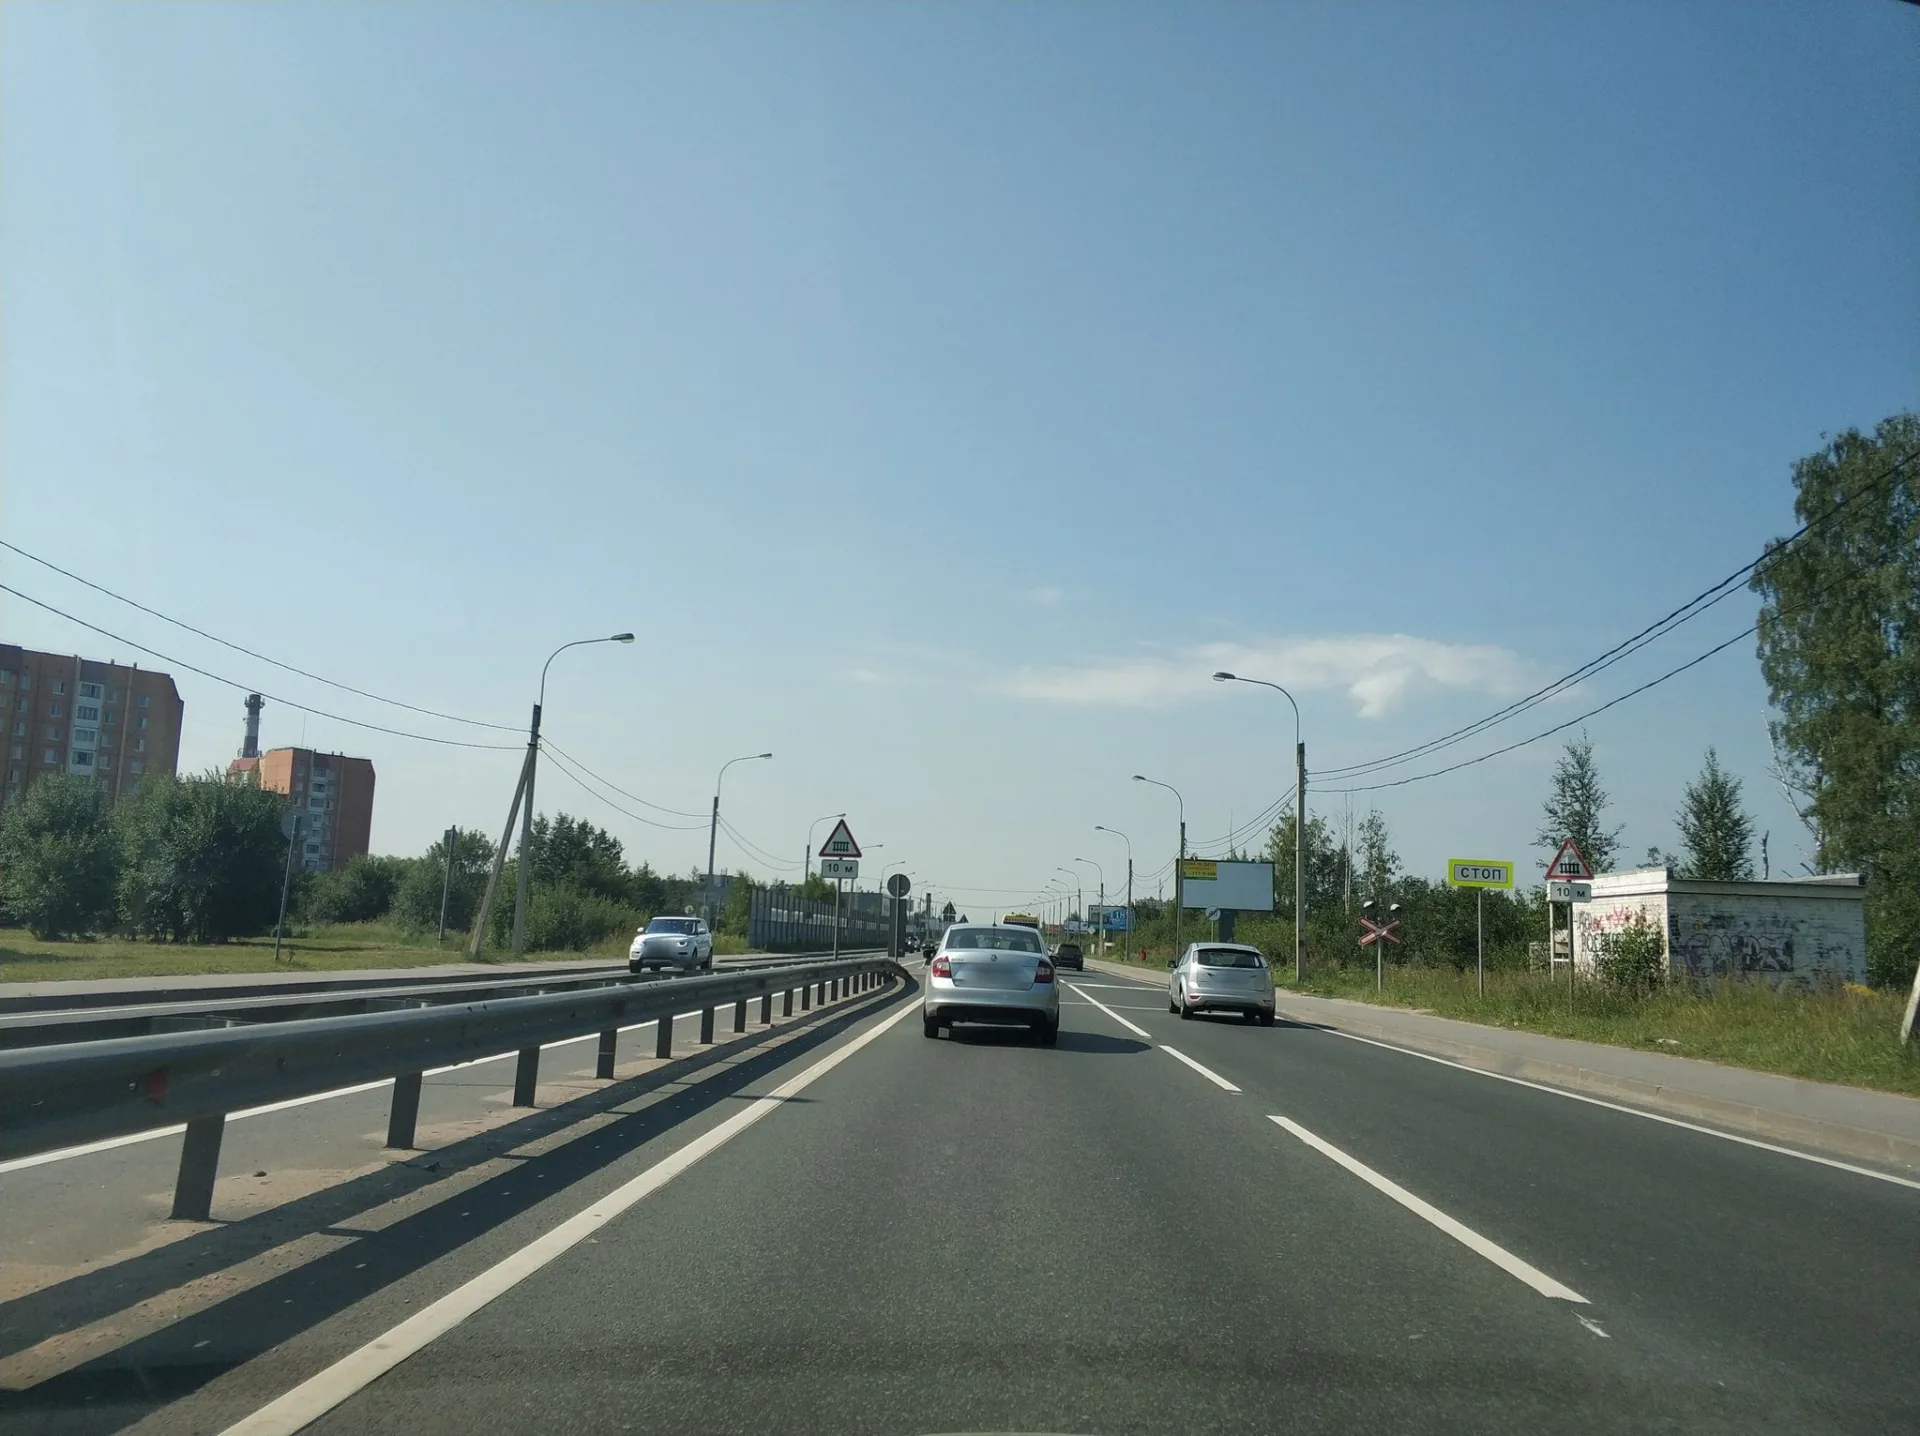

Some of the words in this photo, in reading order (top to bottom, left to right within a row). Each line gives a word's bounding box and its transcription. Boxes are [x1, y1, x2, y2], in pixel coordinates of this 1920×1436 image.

[827, 863, 839, 872] 10
[1461, 867, 1501, 880] СТОП
[1556, 887, 1570, 897] 10
